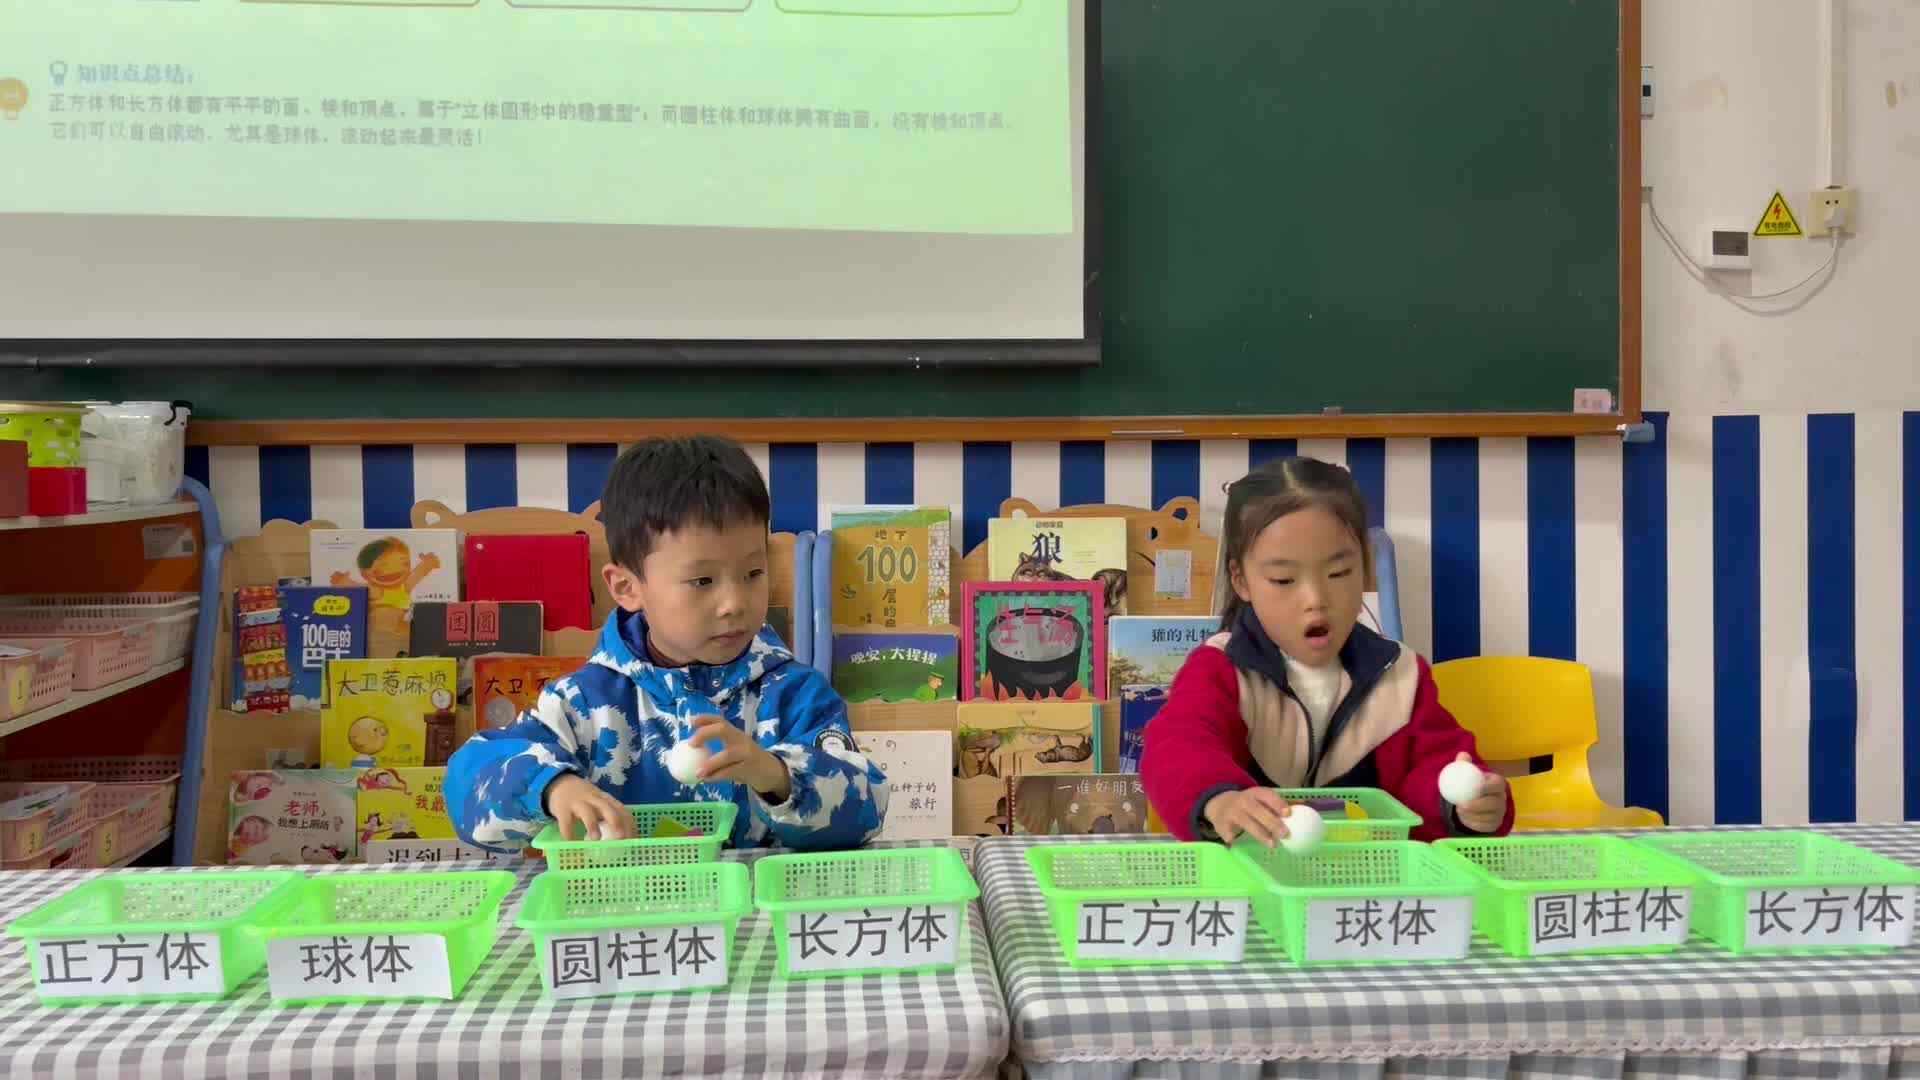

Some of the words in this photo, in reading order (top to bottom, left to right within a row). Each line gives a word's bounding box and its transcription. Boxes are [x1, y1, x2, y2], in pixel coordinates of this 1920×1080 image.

[875, 530, 906, 541] 地下
[1032, 532, 1062, 564] 狼
[857, 544, 917, 584] 100
[337, 670, 447, 697] 大卫惹麻烦
[278, 817, 330, 831] 我想上厕所
[910, 797, 937, 810] 旅行
[789, 905, 948, 961] 长方体
[1077, 898, 1235, 948] 正方体
[1334, 899, 1437, 948] 球体
[1534, 885, 1684, 943] 圆柱体
[1748, 885, 1905, 936] 长方体
[39, 931, 210, 985] 正方体
[300, 935, 414, 984] 球体
[551, 926, 717, 989] 圆柱体
